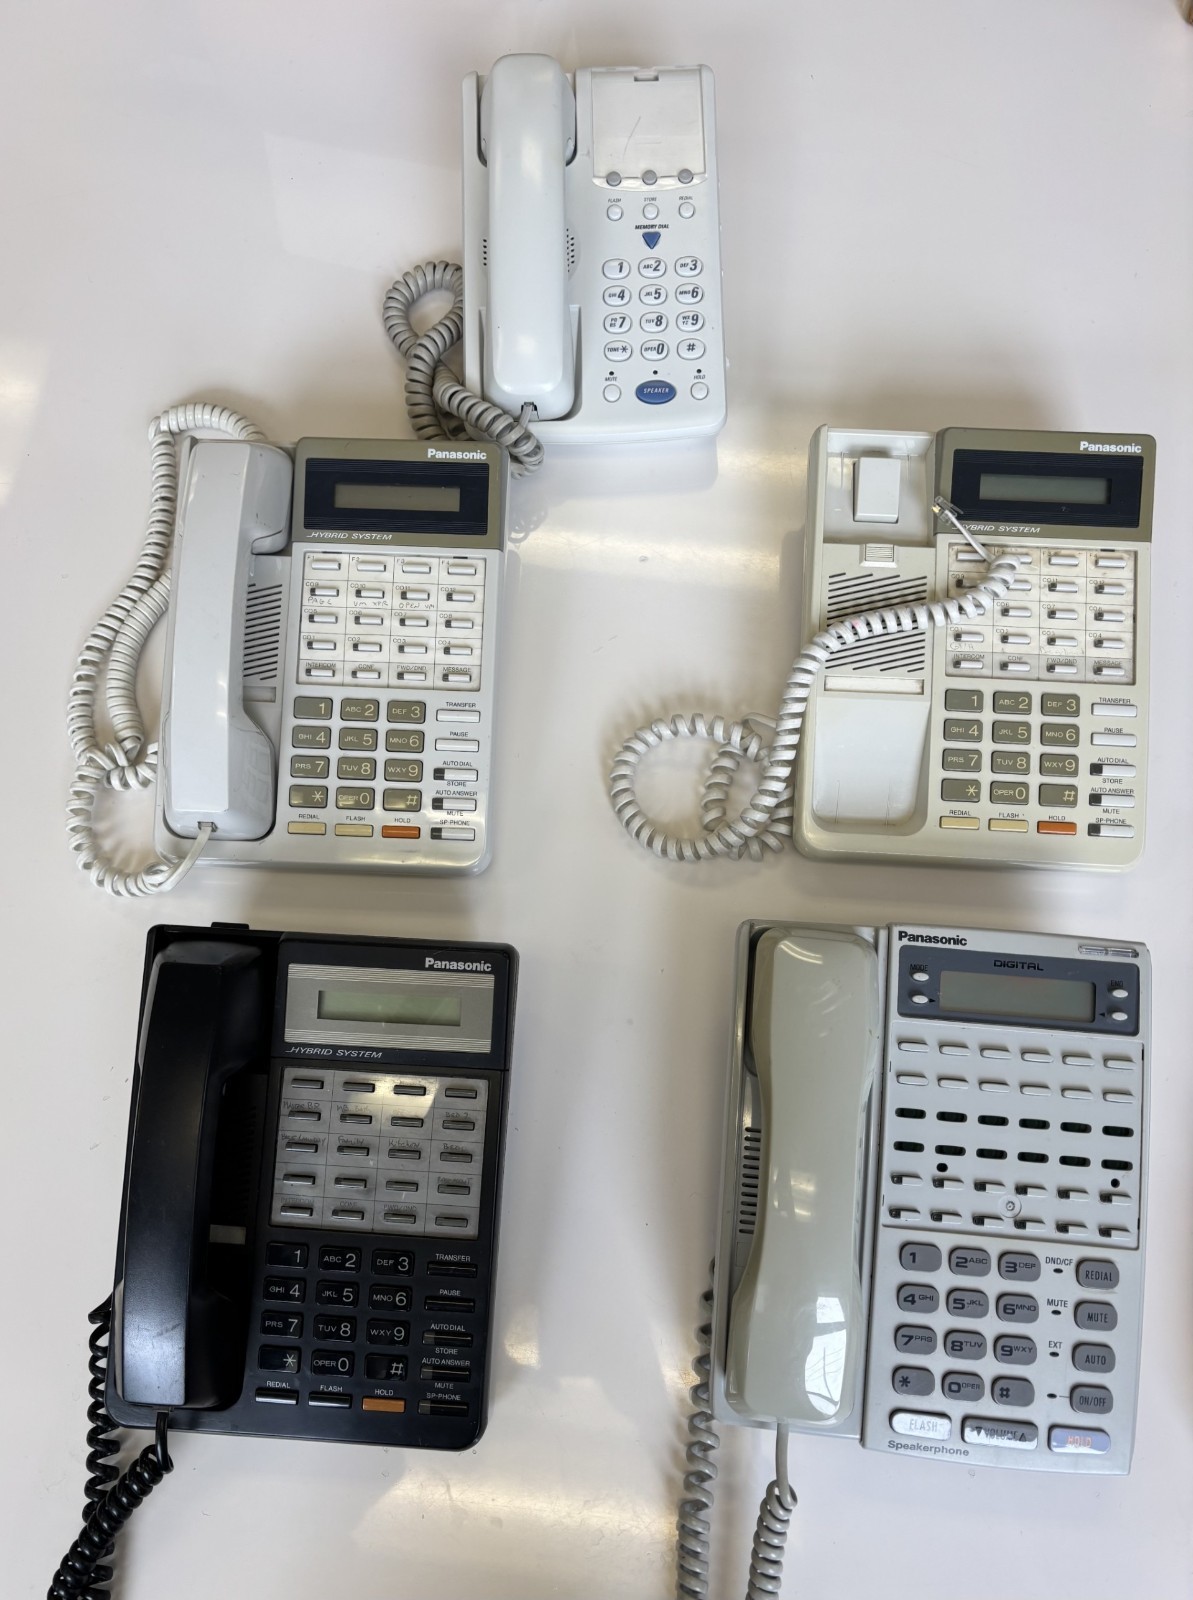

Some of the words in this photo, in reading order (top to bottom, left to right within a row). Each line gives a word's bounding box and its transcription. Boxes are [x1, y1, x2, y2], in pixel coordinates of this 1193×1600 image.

[618, 262, 624, 273] 1
[653, 260, 661, 272] 2
[690, 259, 698, 271] 3
[618, 289, 625, 300] 4
[654, 288, 661, 299] 5
[691, 287, 699, 298] 6
[619, 317, 626, 328] 7
[655, 315, 663, 326] 8
[691, 314, 699, 325] 9
[1080, 441, 1142, 453] Panasonic
[428, 449, 486, 459] Panasonic
[307, 531, 348, 539] HYBRID
[971, 696, 977, 707] 1
[1018, 697, 1028, 709] 2
[1066, 700, 1076, 711] 3
[319, 703, 325, 714] 1
[364, 704, 374, 716] 2
[411, 706, 420, 718] 3
[969, 725, 978, 736] 4
[1018, 727, 1027, 738] 5
[1066, 729, 1076, 741] 6
[316, 732, 325, 743] 4
[362, 734, 372, 745] 5
[410, 735, 419, 747] 6
[969, 755, 978, 766] 7
[1016, 757, 1026, 768] 8
[1065, 760, 1075, 771] 9
[315, 761, 324, 772] 7
[361, 763, 370, 775] 8
[408, 765, 418, 776] 9
[898, 931, 967, 946] Panasonic
[425, 957, 492, 971] Panasonic
[994, 959, 1044, 971] DIGITAL
[286, 1047, 332, 1055] HYBRID
[336, 1049, 382, 1058] SYSTEM
[294, 1250, 301, 1262] 1
[345, 1253, 356, 1267] 2
[436, 1254, 470, 1262] TRANSFER
[909, 1252, 916, 1263] 1
[1045, 1257, 1074, 1266] DND/CF
[398, 1257, 409, 1271] 3
[955, 1256, 968, 1268] 2
[1005, 1262, 1017, 1273] 3
[1085, 1270, 1112, 1282] REDIAL
[289, 1284, 300, 1297] 4
[342, 1288, 353, 1302] 5
[373, 1294, 393, 1302] MNO
[396, 1292, 406, 1306] 6
[903, 1294, 916, 1305] 4
[918, 1294, 934, 1302] GHI
[953, 1299, 965, 1310] 5
[1047, 1299, 1068, 1308] MUTE
[1003, 1304, 1015, 1314] 6
[1016, 1304, 1036, 1312] MNO
[1087, 1312, 1108, 1323] MUTE
[288, 1319, 298, 1332] 7
[340, 1323, 351, 1336] 8
[394, 1327, 404, 1340] 9
[901, 1335, 914, 1346] 7
[951, 1340, 963, 1352] 8
[1049, 1341, 1062, 1349] EXT
[1001, 1345, 1013, 1356] 9
[1085, 1354, 1106, 1365] AUTO
[962, 1382, 980, 1390] OPER
[1079, 1396, 1106, 1407] ON/OFF
[909, 1419, 938, 1432] FLASH
[1066, 1435, 1092, 1448] HOLD
[887, 1440, 969, 1457] Speakerphone
